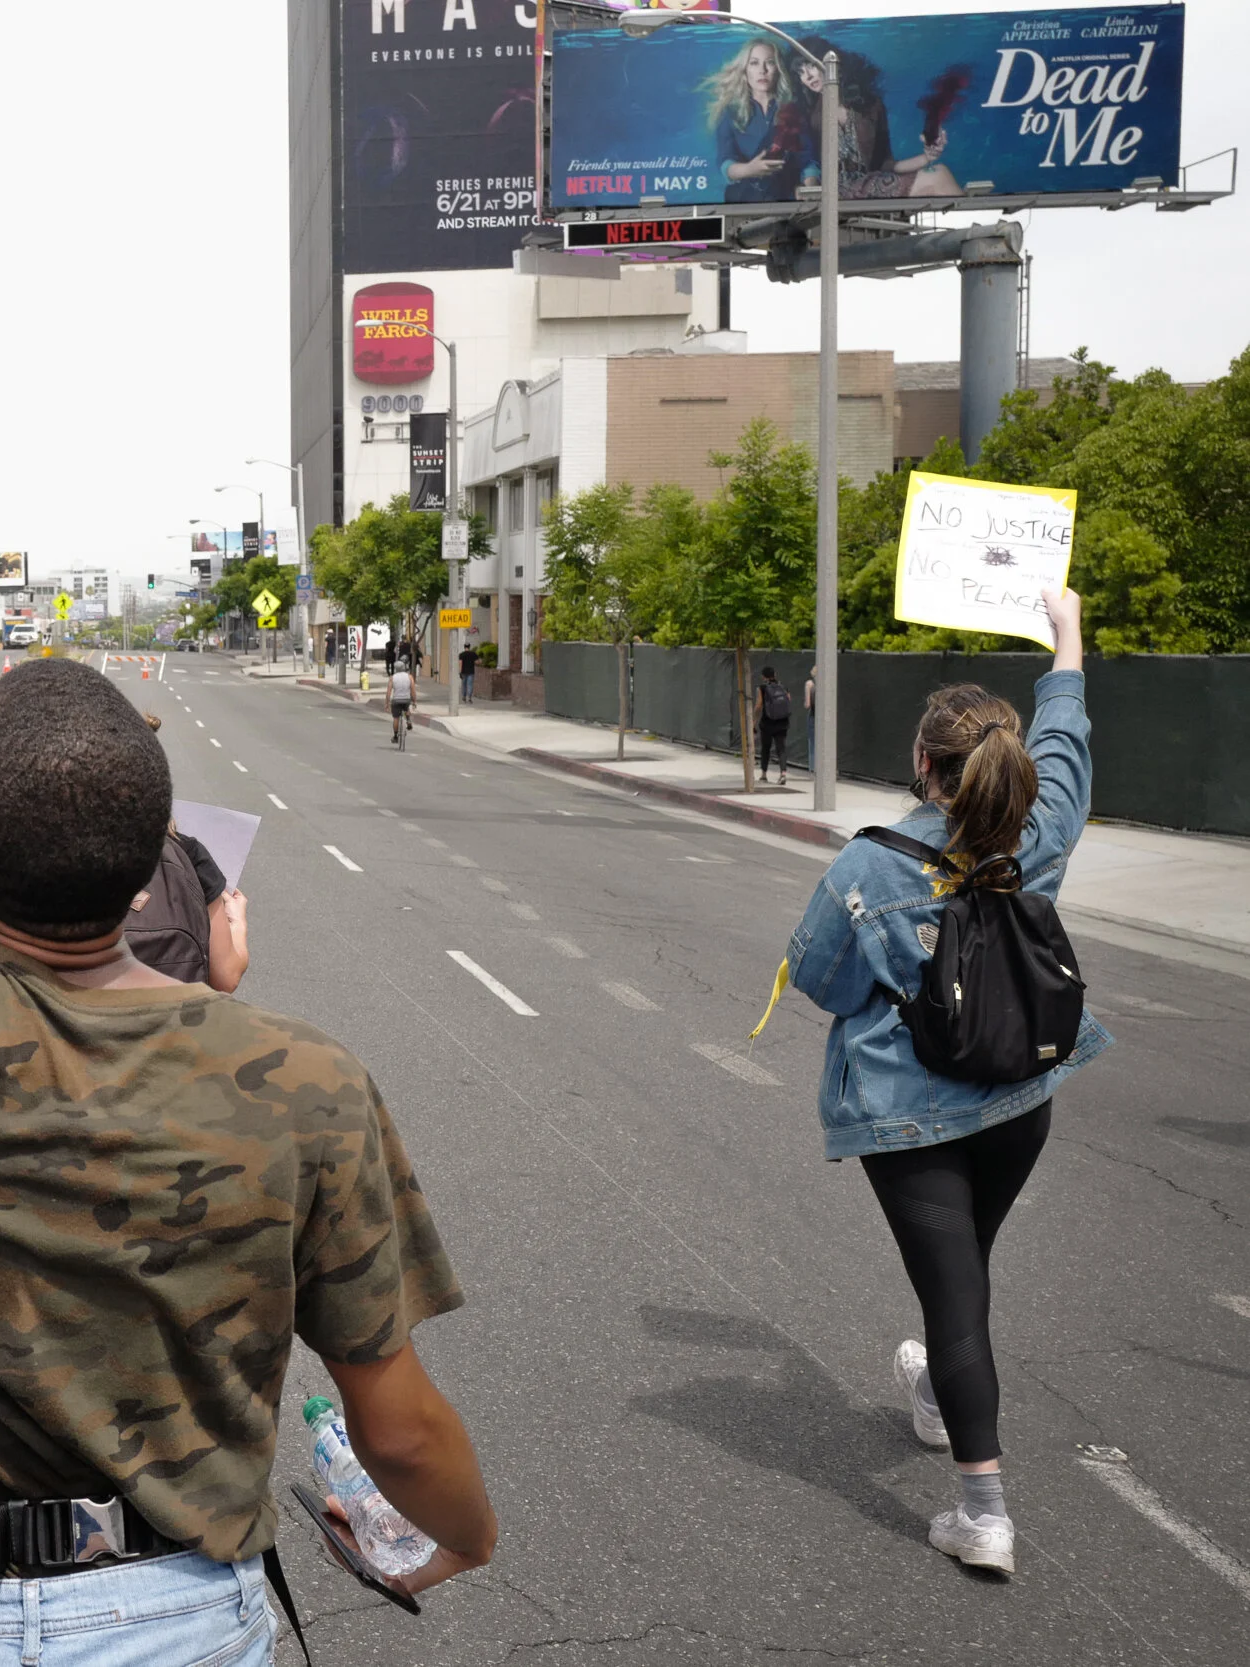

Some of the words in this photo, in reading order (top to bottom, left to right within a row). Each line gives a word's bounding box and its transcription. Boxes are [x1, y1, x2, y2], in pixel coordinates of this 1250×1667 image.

[1013, 20, 1060, 31] Christina
[1105, 15, 1134, 27] Linda
[1002, 28, 1072, 42] APPLEGATE
[1081, 24, 1159, 38] CARDELLINI
[371, 48, 455, 62] EVERYONE
[467, 47, 482, 58] IS
[495, 45, 533, 56] GUIL
[981, 41, 1156, 108] Dead
[1019, 106, 1049, 136] to
[1038, 105, 1143, 168] Me
[567, 159, 611, 172] Friends
[611, 160, 631, 172] you
[632, 158, 668, 169] would
[669, 157, 688, 169] kill
[436, 178, 481, 192] SERIES
[487, 176, 535, 190] PREMIE
[566, 175, 633, 197] NETFLIX
[654, 176, 693, 191] MAY
[696, 175, 707, 190] 8
[436, 191, 481, 215] 6/21
[484, 199, 501, 211] AT
[503, 190, 537, 210] 9P
[437, 218, 465, 230] AND
[467, 215, 516, 229] STREAM
[519, 215, 529, 227] IT
[584, 212, 597, 221] 28
[606, 220, 683, 245] NETFLIX
[361, 308, 429, 323] WELLS
[363, 324, 429, 339] FARGO
[361, 394, 424, 414] 9000
[412, 449, 444, 457] SUNSET
[920, 501, 963, 528] NO
[971, 509, 1072, 545] JUSTICE
[908, 547, 951, 578] NO
[961, 577, 1050, 615] PEACE
[441, 614, 469, 623] AHEAD
[349, 627, 358, 660] PARK
